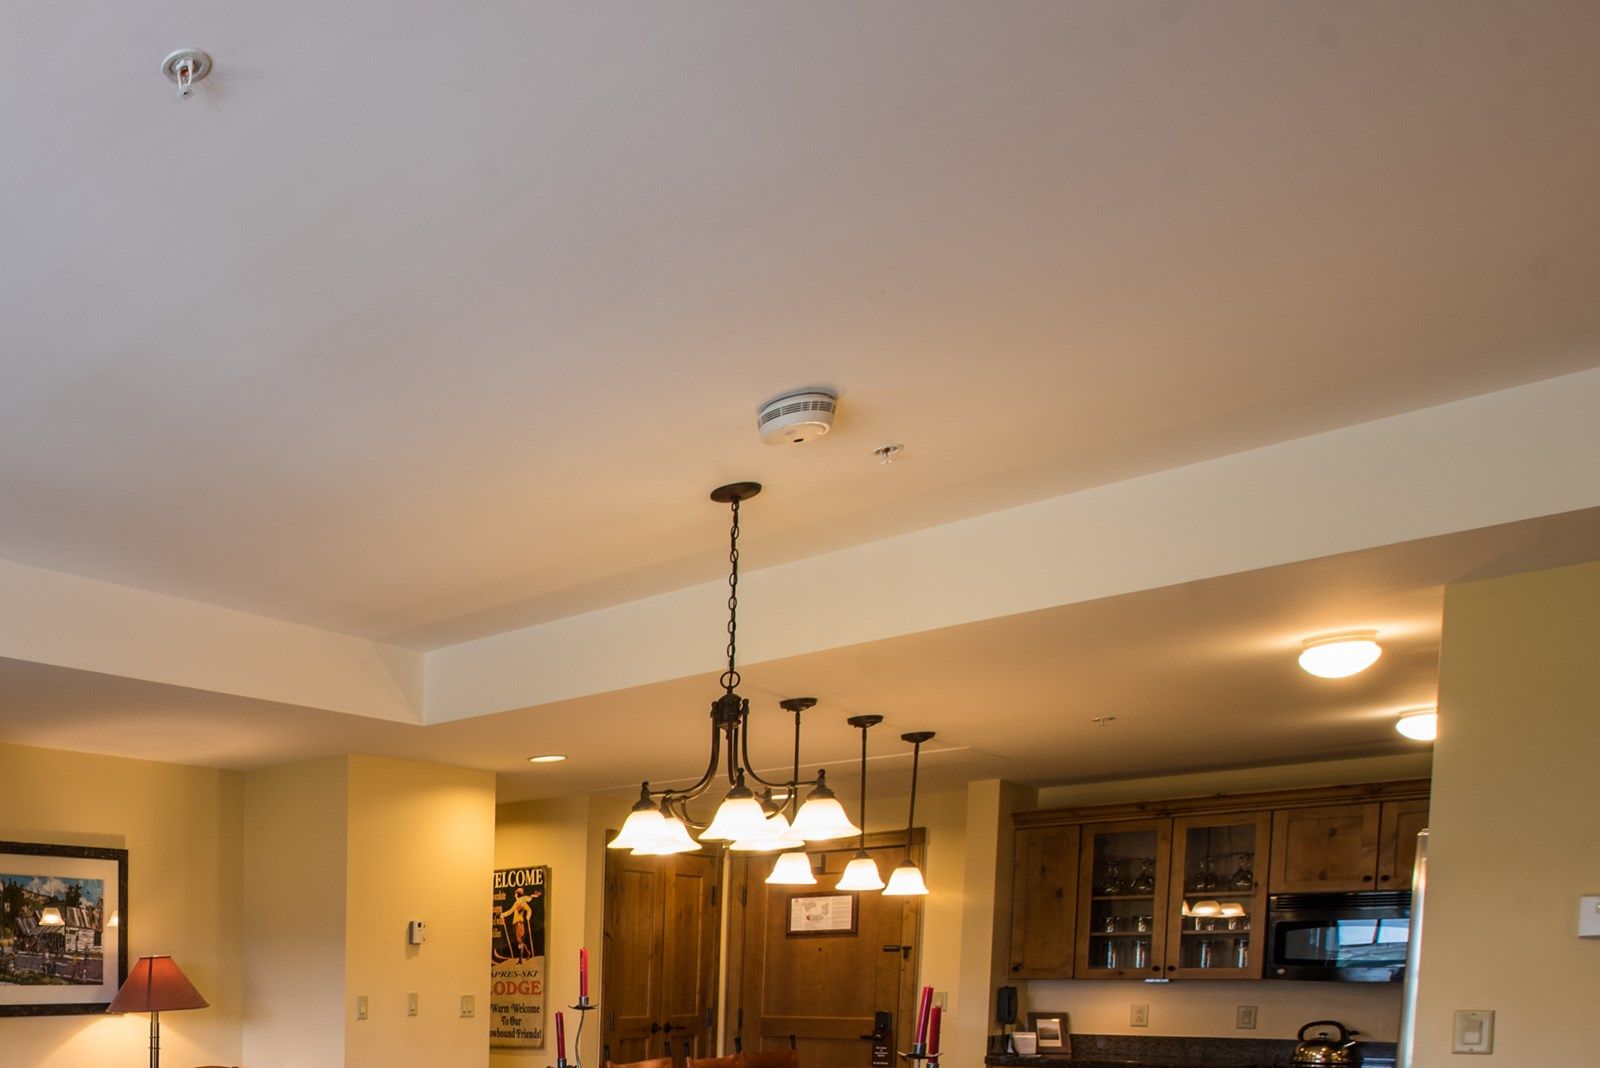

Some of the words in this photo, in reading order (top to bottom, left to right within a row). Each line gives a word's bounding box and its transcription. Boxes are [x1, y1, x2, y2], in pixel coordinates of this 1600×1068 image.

[493, 869, 543, 888] ELCOME
[491, 981, 542, 995] ODGE
[511, 1003, 540, 1013] Welcome
[500, 1015, 509, 1026] To
[515, 1028, 542, 1039] Friends!
